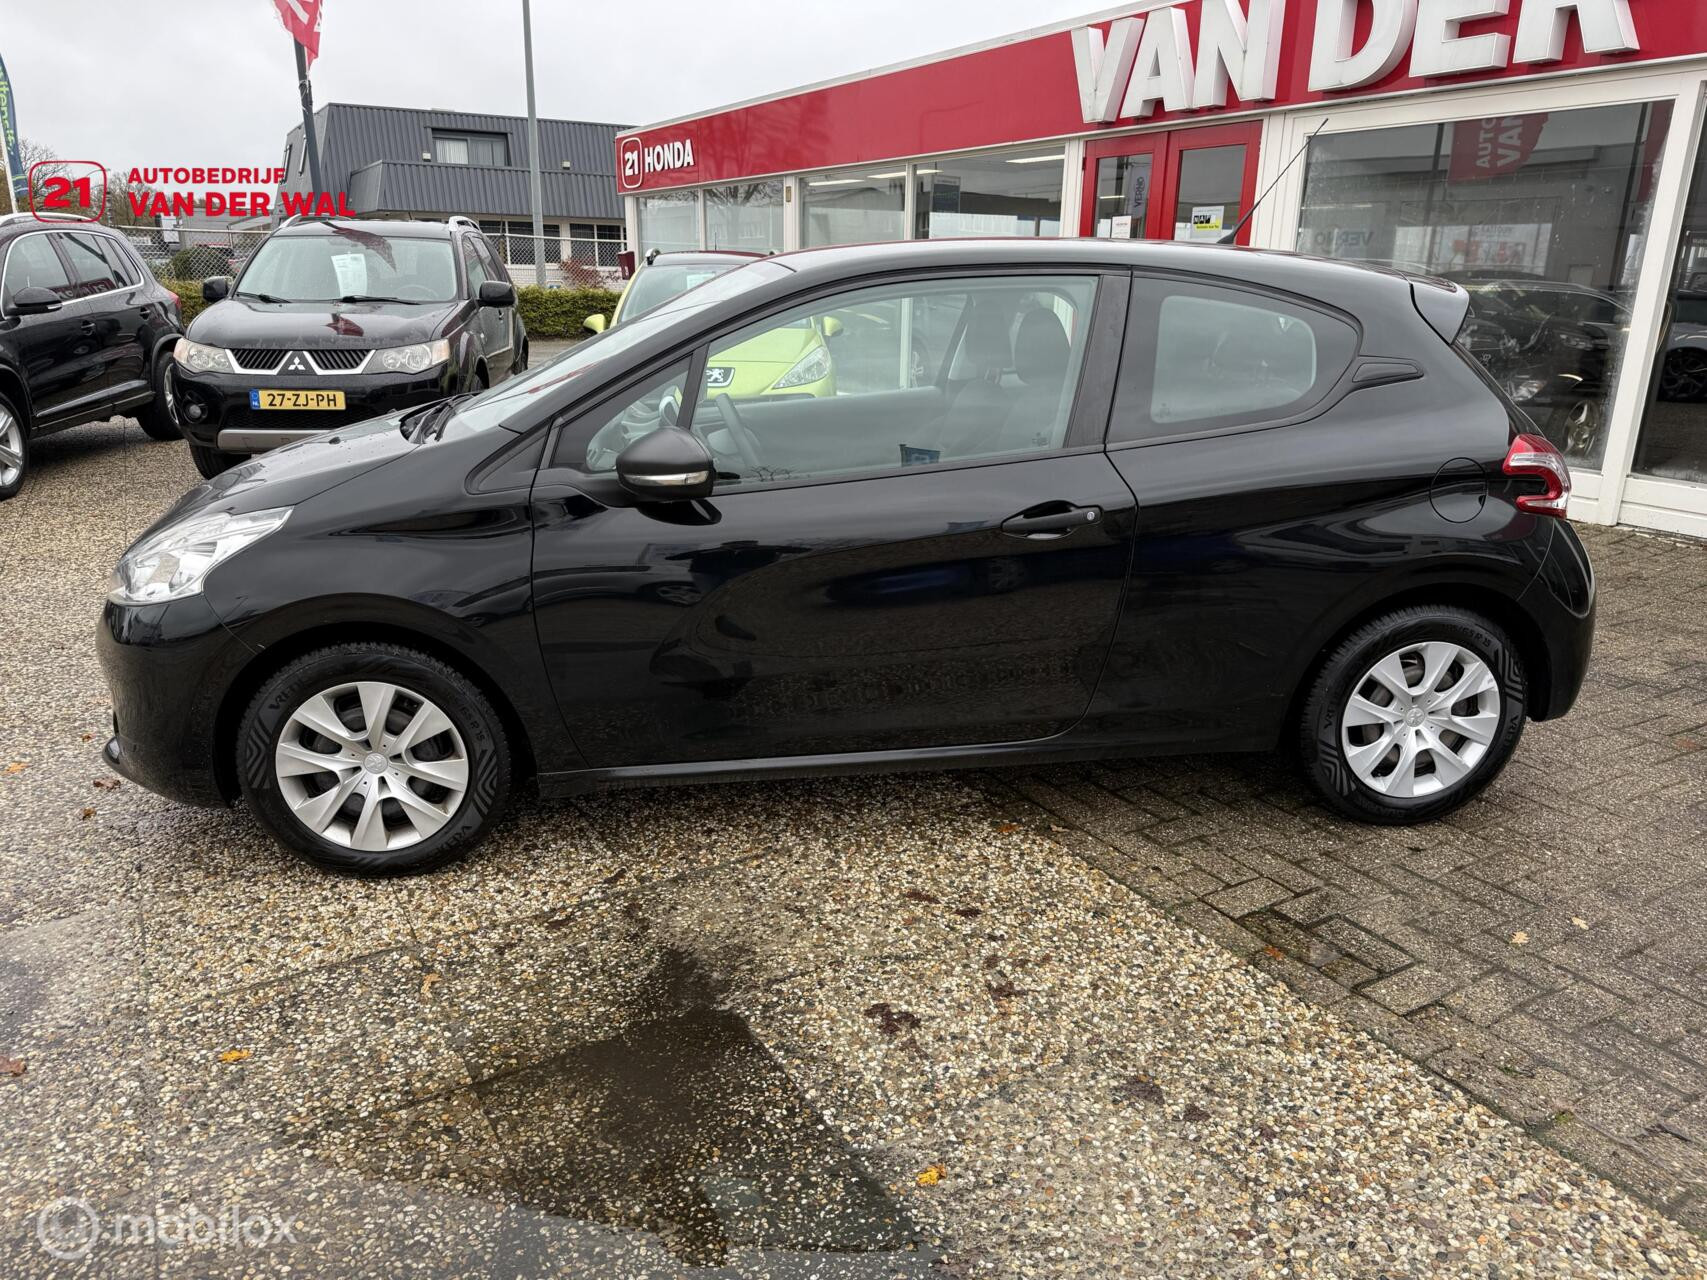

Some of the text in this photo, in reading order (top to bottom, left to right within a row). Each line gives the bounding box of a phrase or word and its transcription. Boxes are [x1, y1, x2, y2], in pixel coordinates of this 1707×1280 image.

[1071, 0, 1286, 123] VAN
[624, 139, 695, 176] 21 HONDA
[267, 393, 337, 407] 27-ZJ-PH
